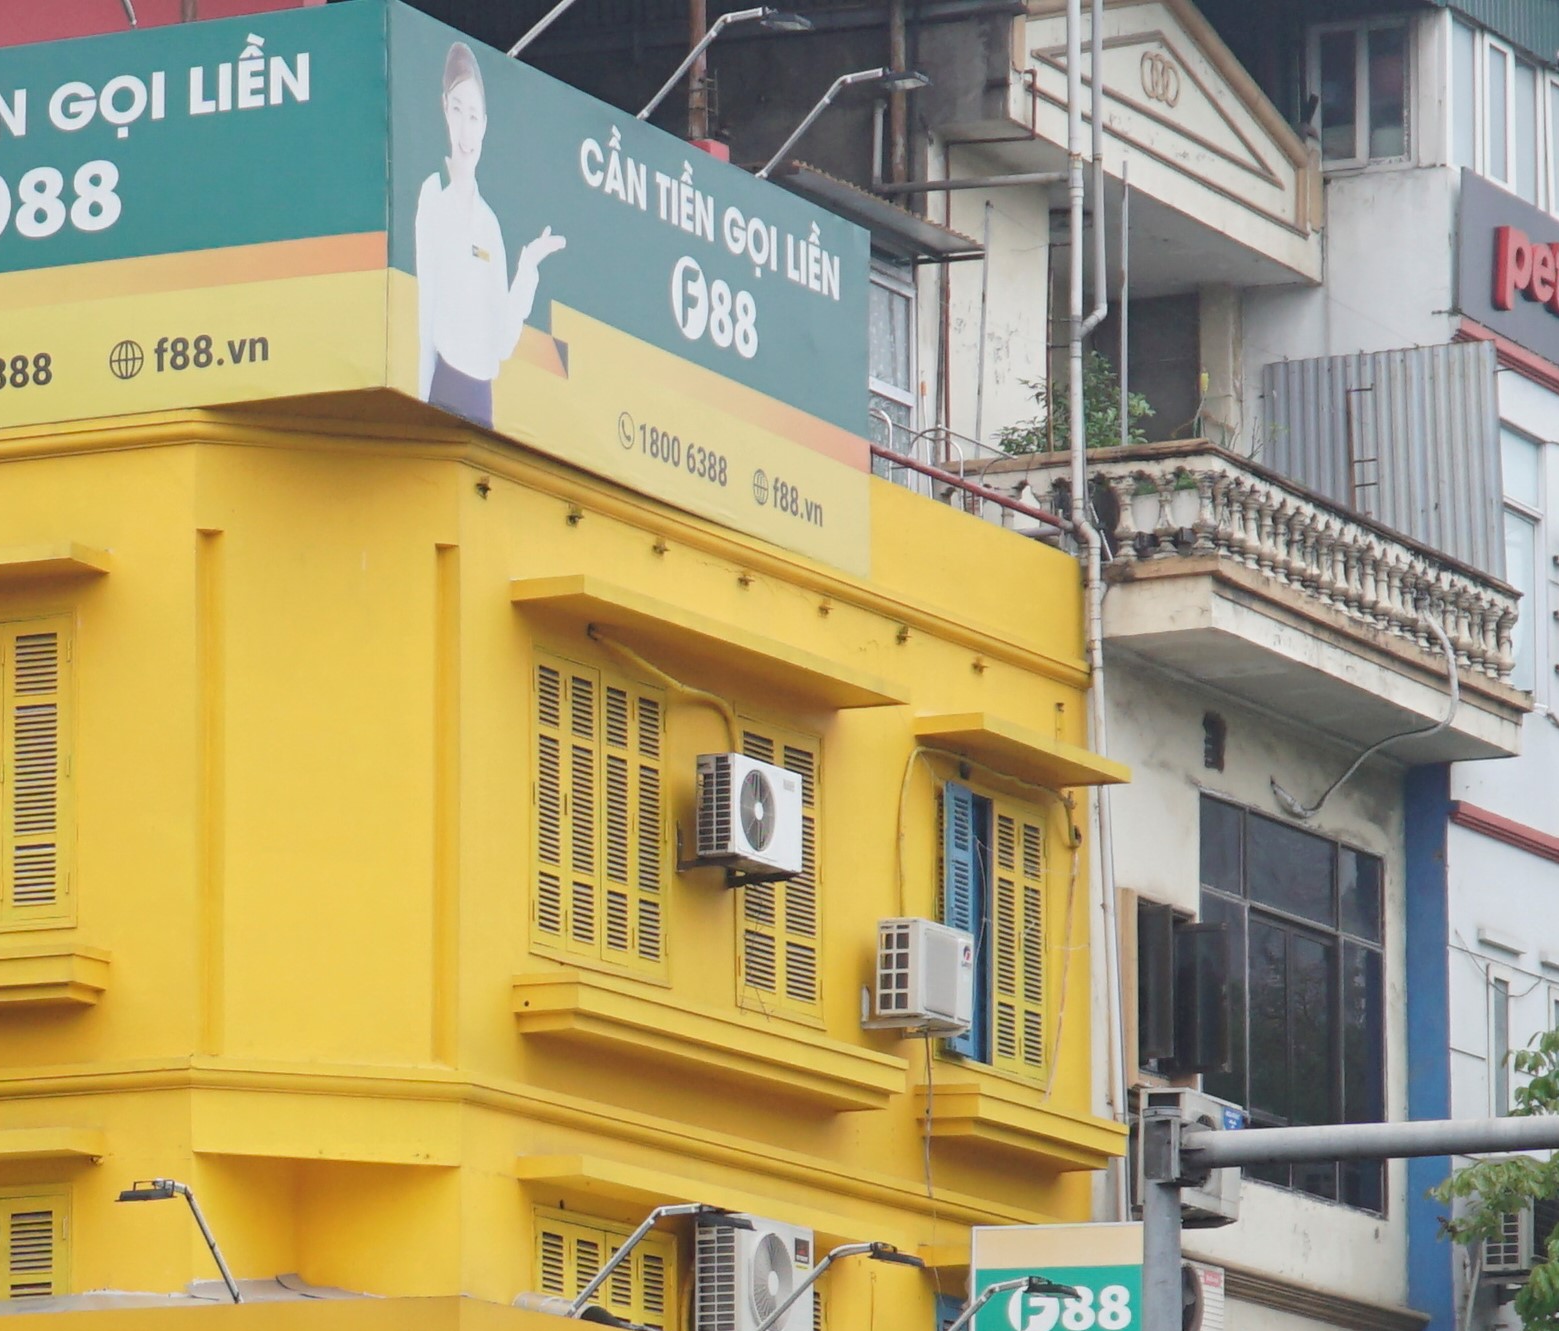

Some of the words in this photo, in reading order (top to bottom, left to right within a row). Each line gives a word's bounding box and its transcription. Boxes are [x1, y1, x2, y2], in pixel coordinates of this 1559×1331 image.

[49, 70, 165, 139] GỌI
[189, 33, 310, 116] LIỀN
[580, 124, 647, 211] CẦN
[655, 159, 714, 243] TIỀN
[723, 206, 778, 279] GỌI
[786, 221, 841, 301] LIỀN
[671, 255, 758, 359] F88
[154, 334, 270, 372] f88.vn
[639, 422, 681, 466] 1800
[686, 442, 729, 488] 6388
[772, 474, 824, 529] f88.vn
